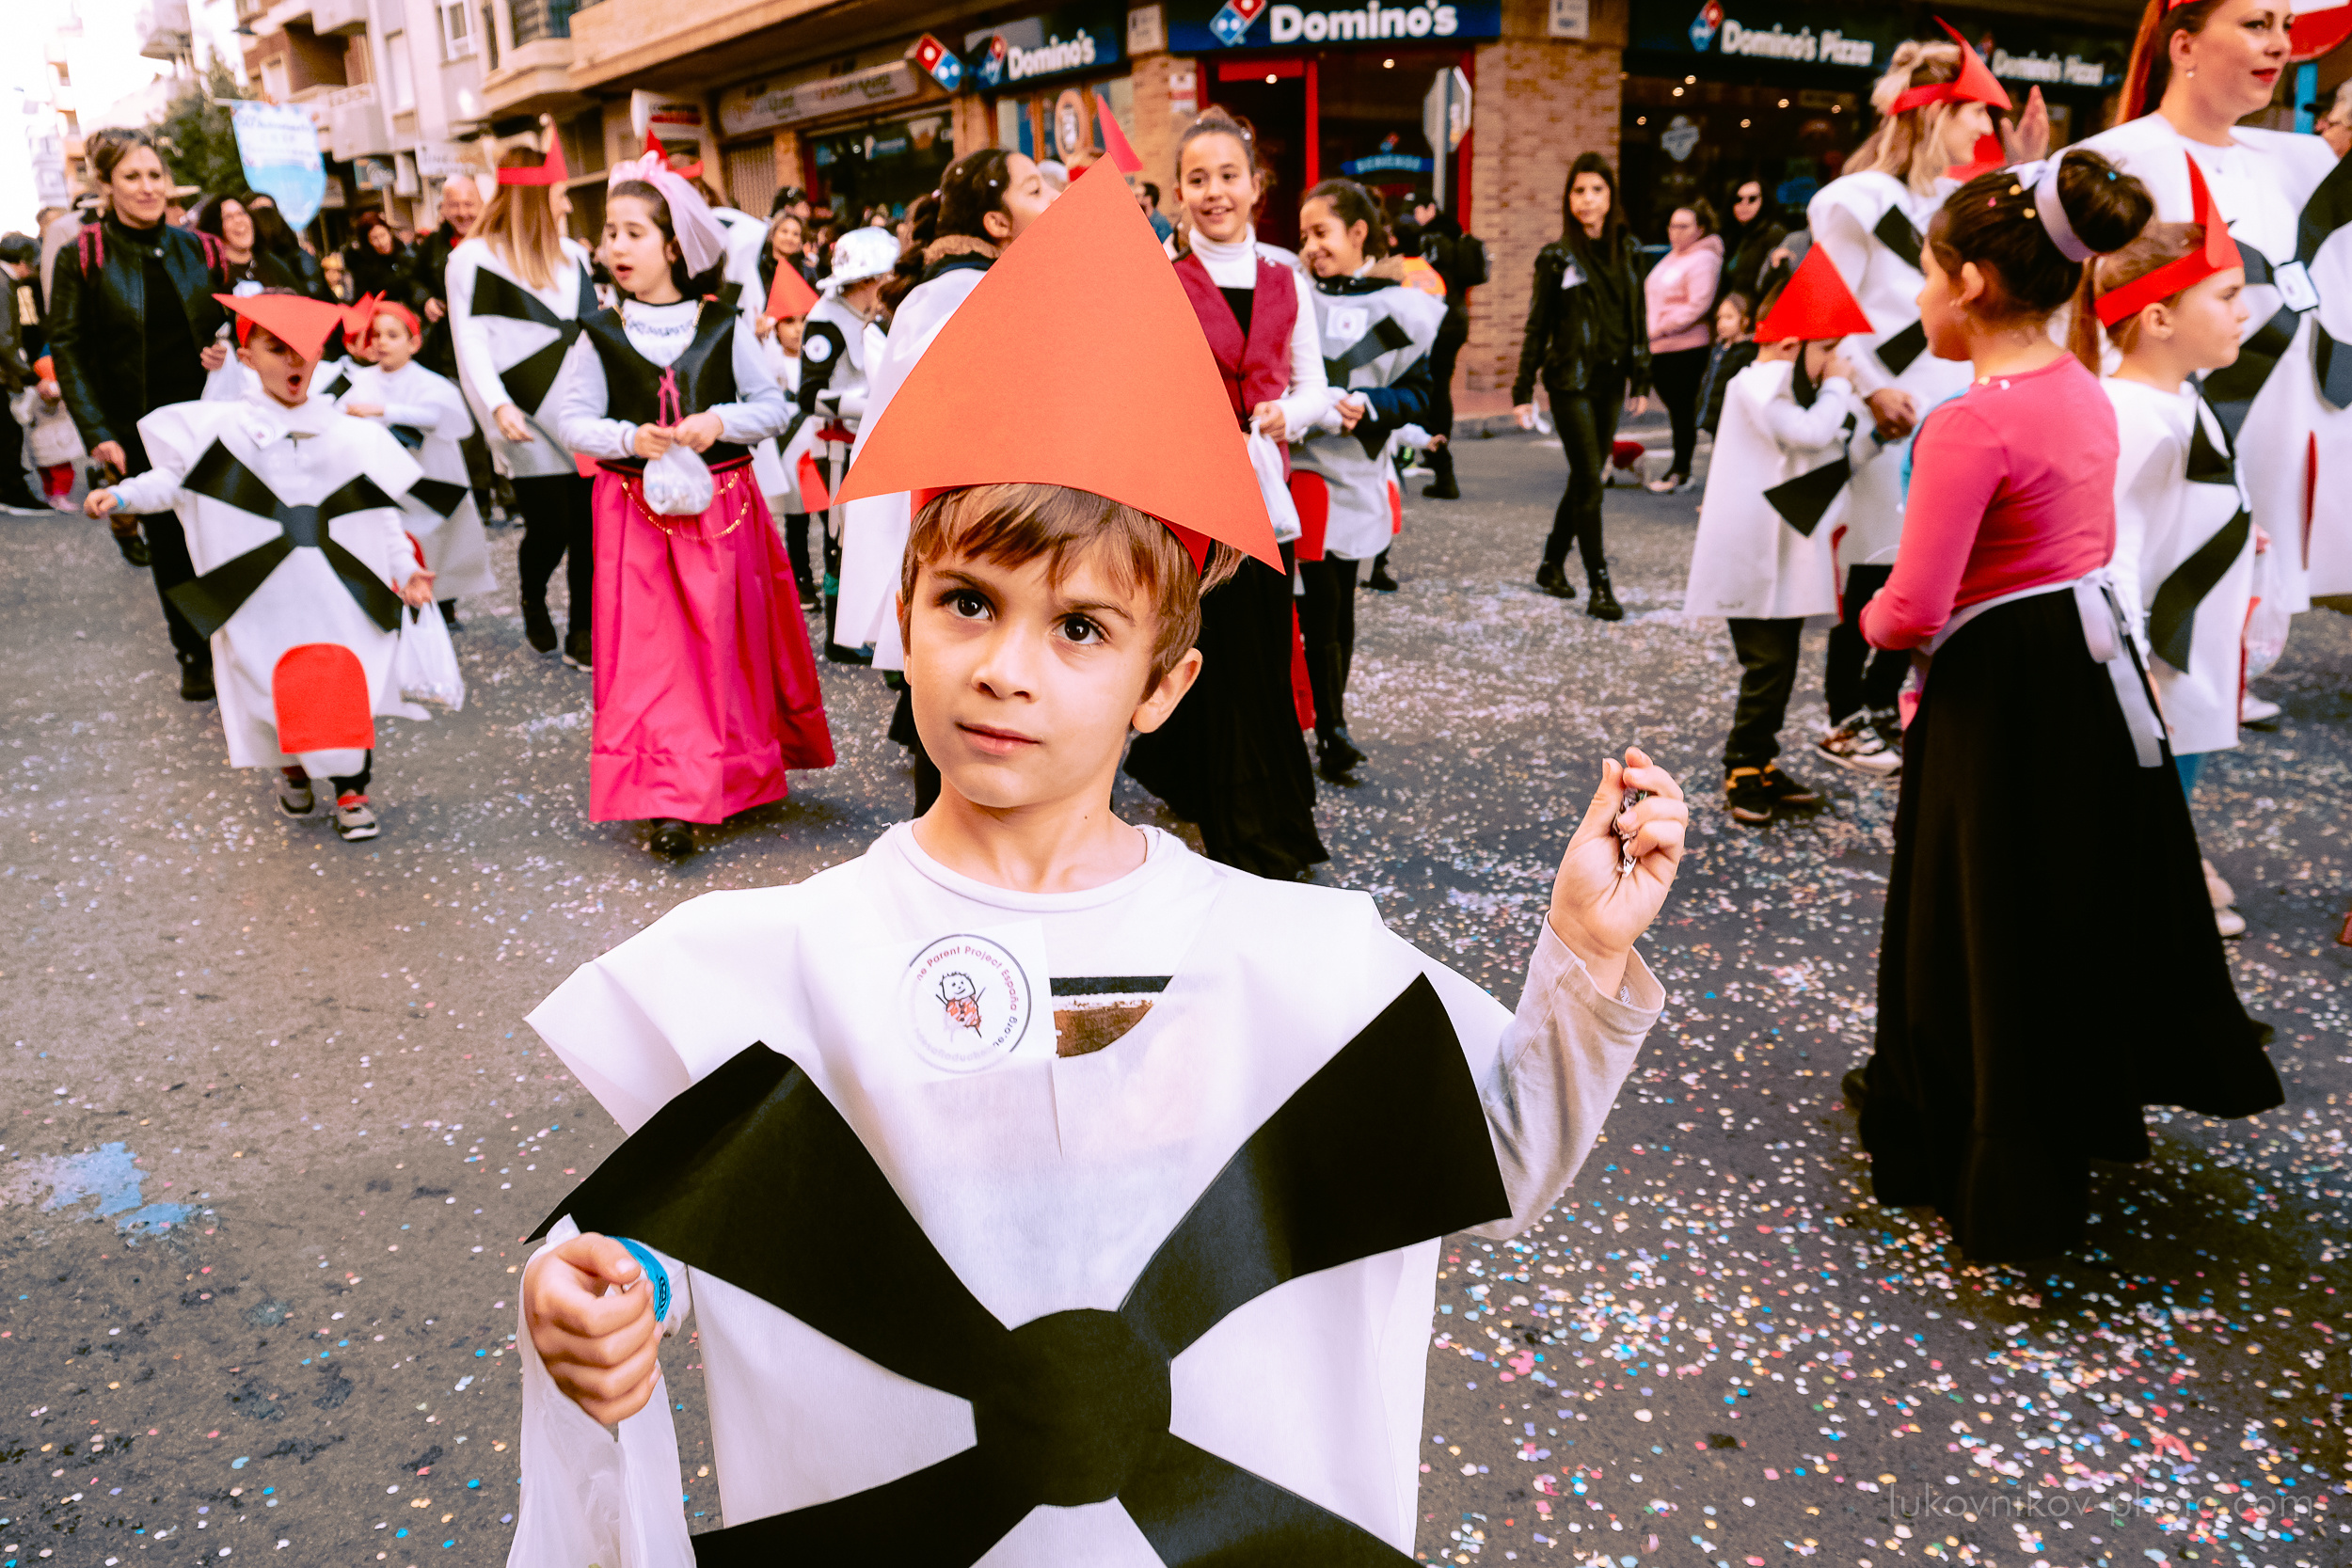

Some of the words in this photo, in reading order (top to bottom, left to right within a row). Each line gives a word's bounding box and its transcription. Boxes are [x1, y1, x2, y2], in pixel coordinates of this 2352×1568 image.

[1270, 0, 1458, 43] Domino's
[1721, 19, 1818, 62] Domino's
[1819, 29, 1874, 67] Pizza
[1007, 27, 1096, 81] Domino's
[927, 945, 961, 967] Parent
[964, 945, 1003, 970] Project
[1001, 969, 1019, 1011] España
